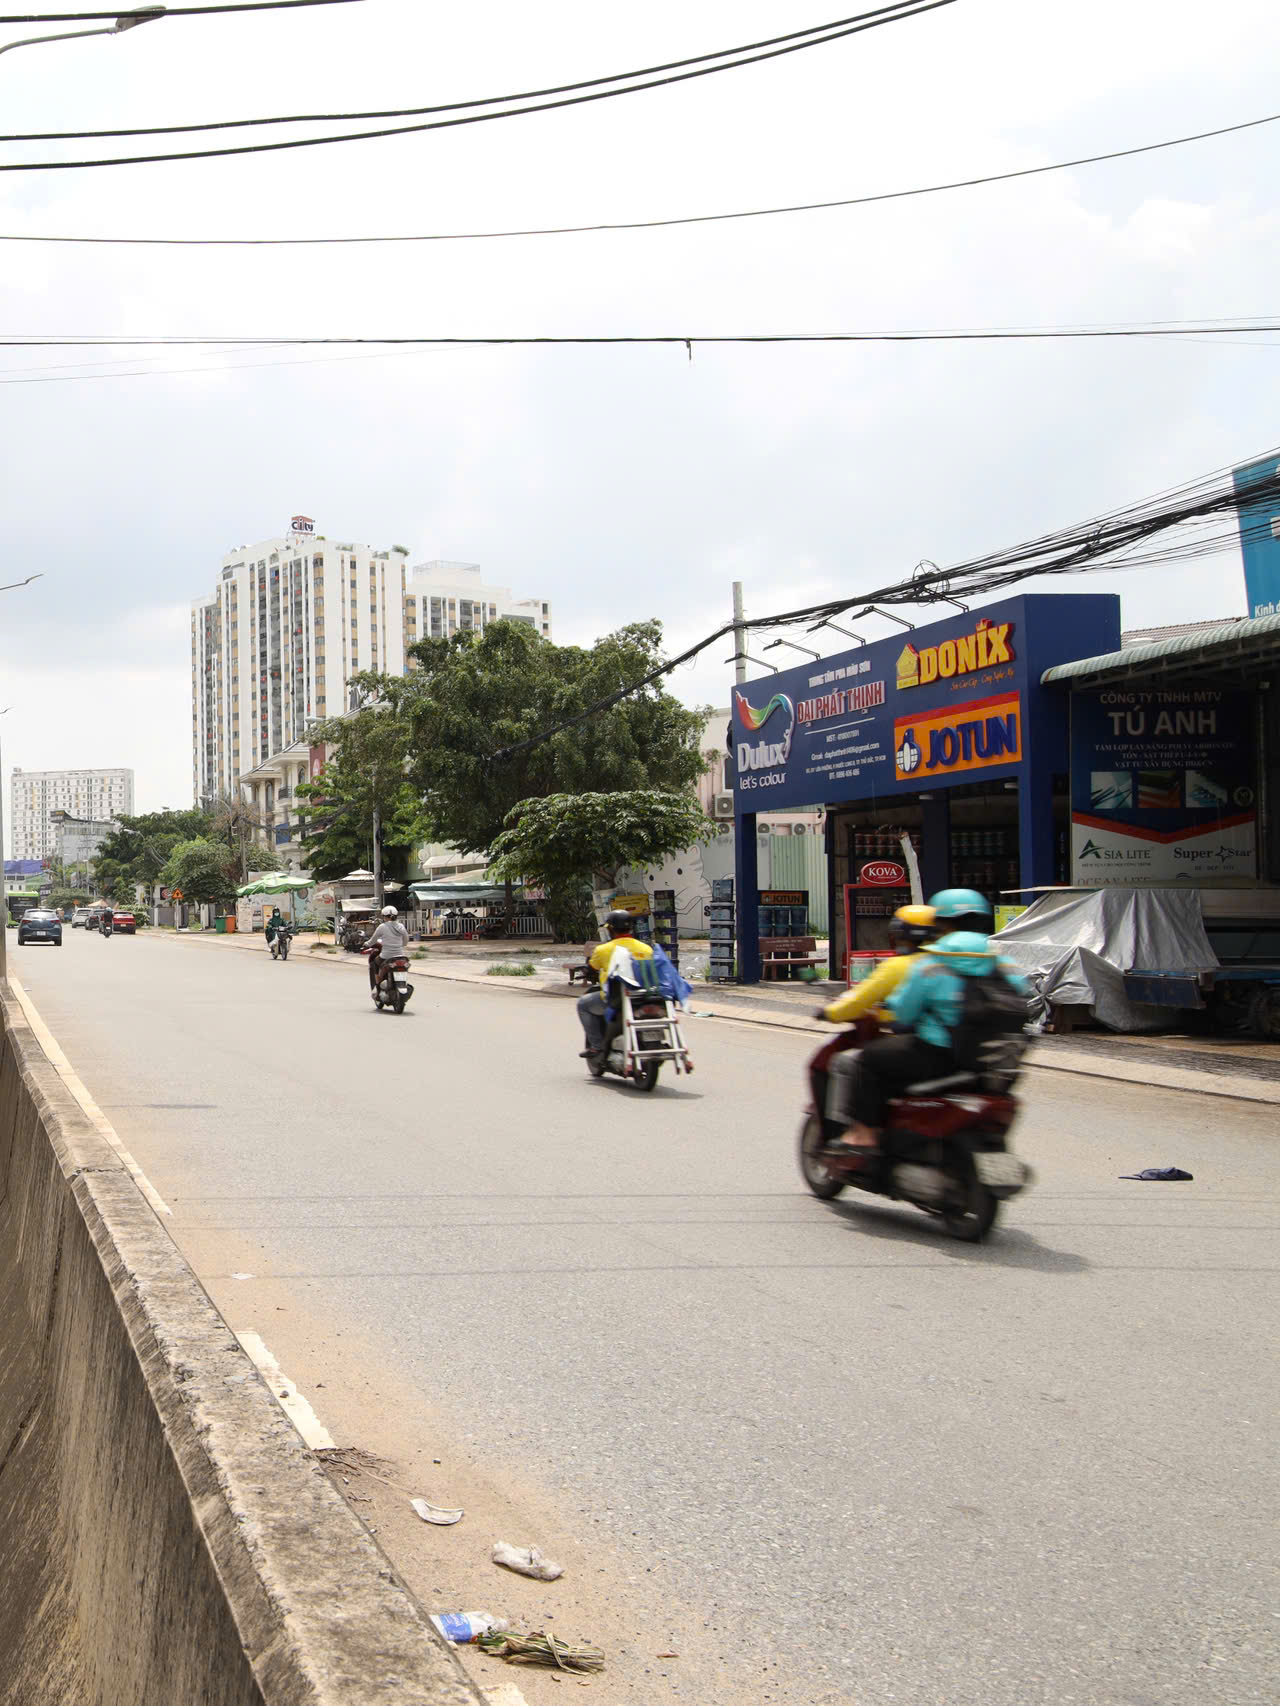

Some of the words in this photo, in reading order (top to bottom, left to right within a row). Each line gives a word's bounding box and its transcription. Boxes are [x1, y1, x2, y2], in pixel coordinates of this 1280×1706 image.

[797, 698, 816, 727] ĐẠI
[816, 687, 846, 719] PHÁT
[847, 680, 886, 714] THỊNH
[1100, 689, 1136, 704] CÔNG
[1138, 691, 1154, 703] TY
[1156, 691, 1191, 703] TNHH
[1194, 690, 1222, 702] MTV
[1107, 704, 1145, 736] TÚ
[1154, 709, 1218, 736] ANH
[926, 713, 1018, 768] JOTUN
[737, 740, 787, 773] Dulux
[740, 775, 758, 790] let's
[759, 771, 787, 787] colour
[1127, 849, 1152, 860] LITE
[1173, 847, 1214, 861] Super
[1227, 847, 1252, 858] Star
[868, 867, 897, 877] KOVA
